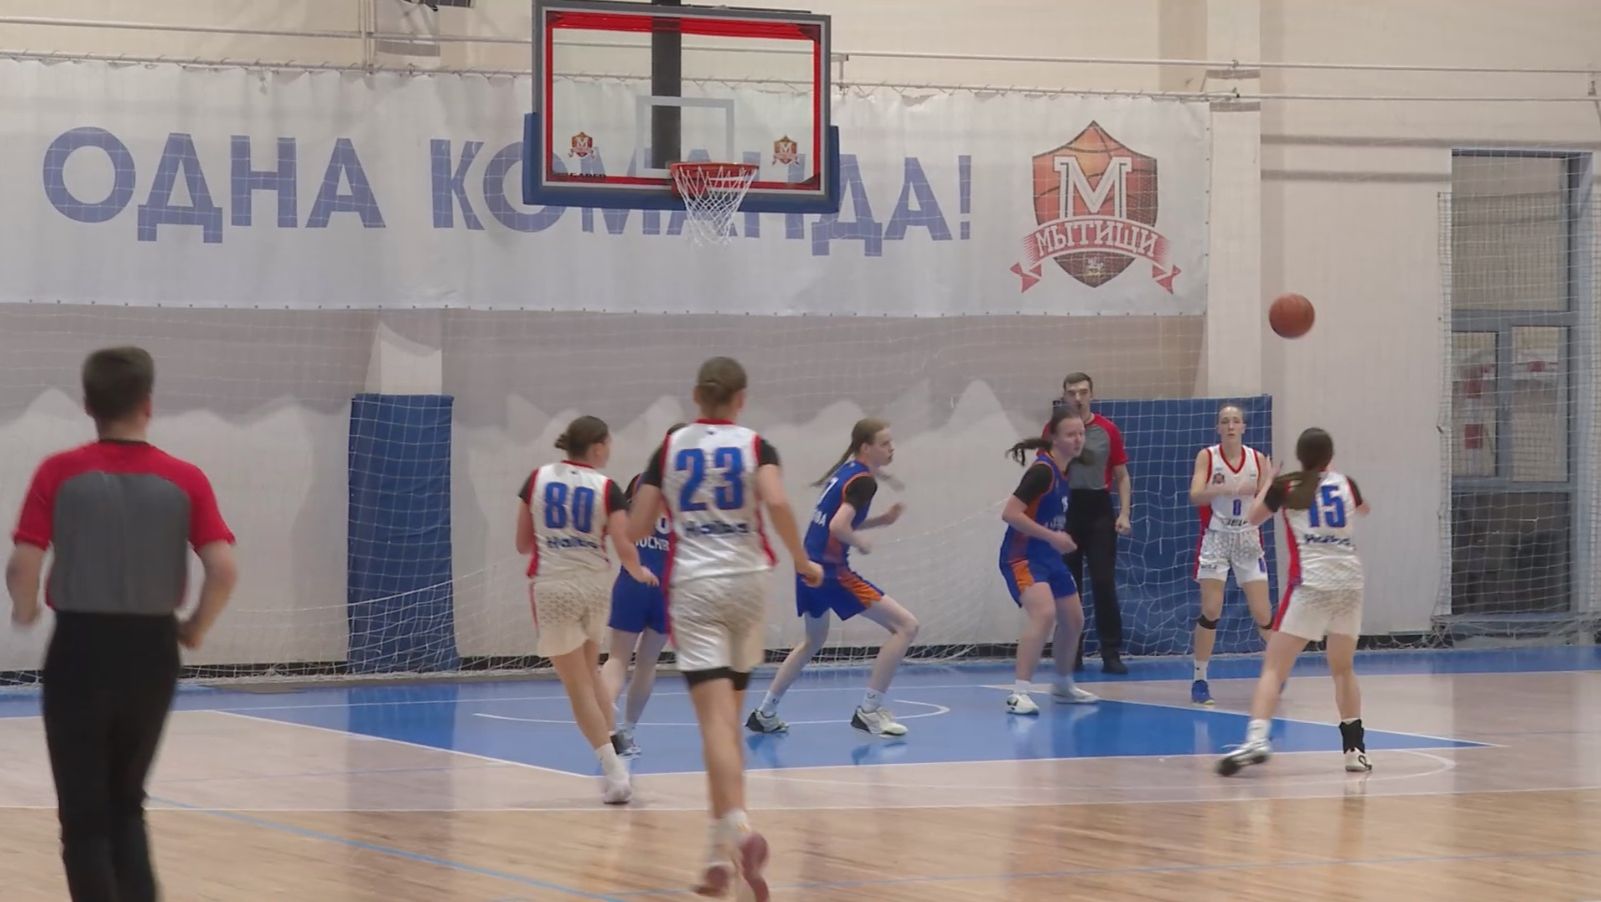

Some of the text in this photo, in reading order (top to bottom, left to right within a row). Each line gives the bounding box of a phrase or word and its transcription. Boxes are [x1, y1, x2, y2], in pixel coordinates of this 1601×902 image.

[43, 126, 386, 244] ОДНА
[1035, 220, 1159, 257] МЫТИЩИ
[675, 447, 744, 512] 23
[544, 482, 595, 534] 80
[1308, 485, 1346, 528] 15
